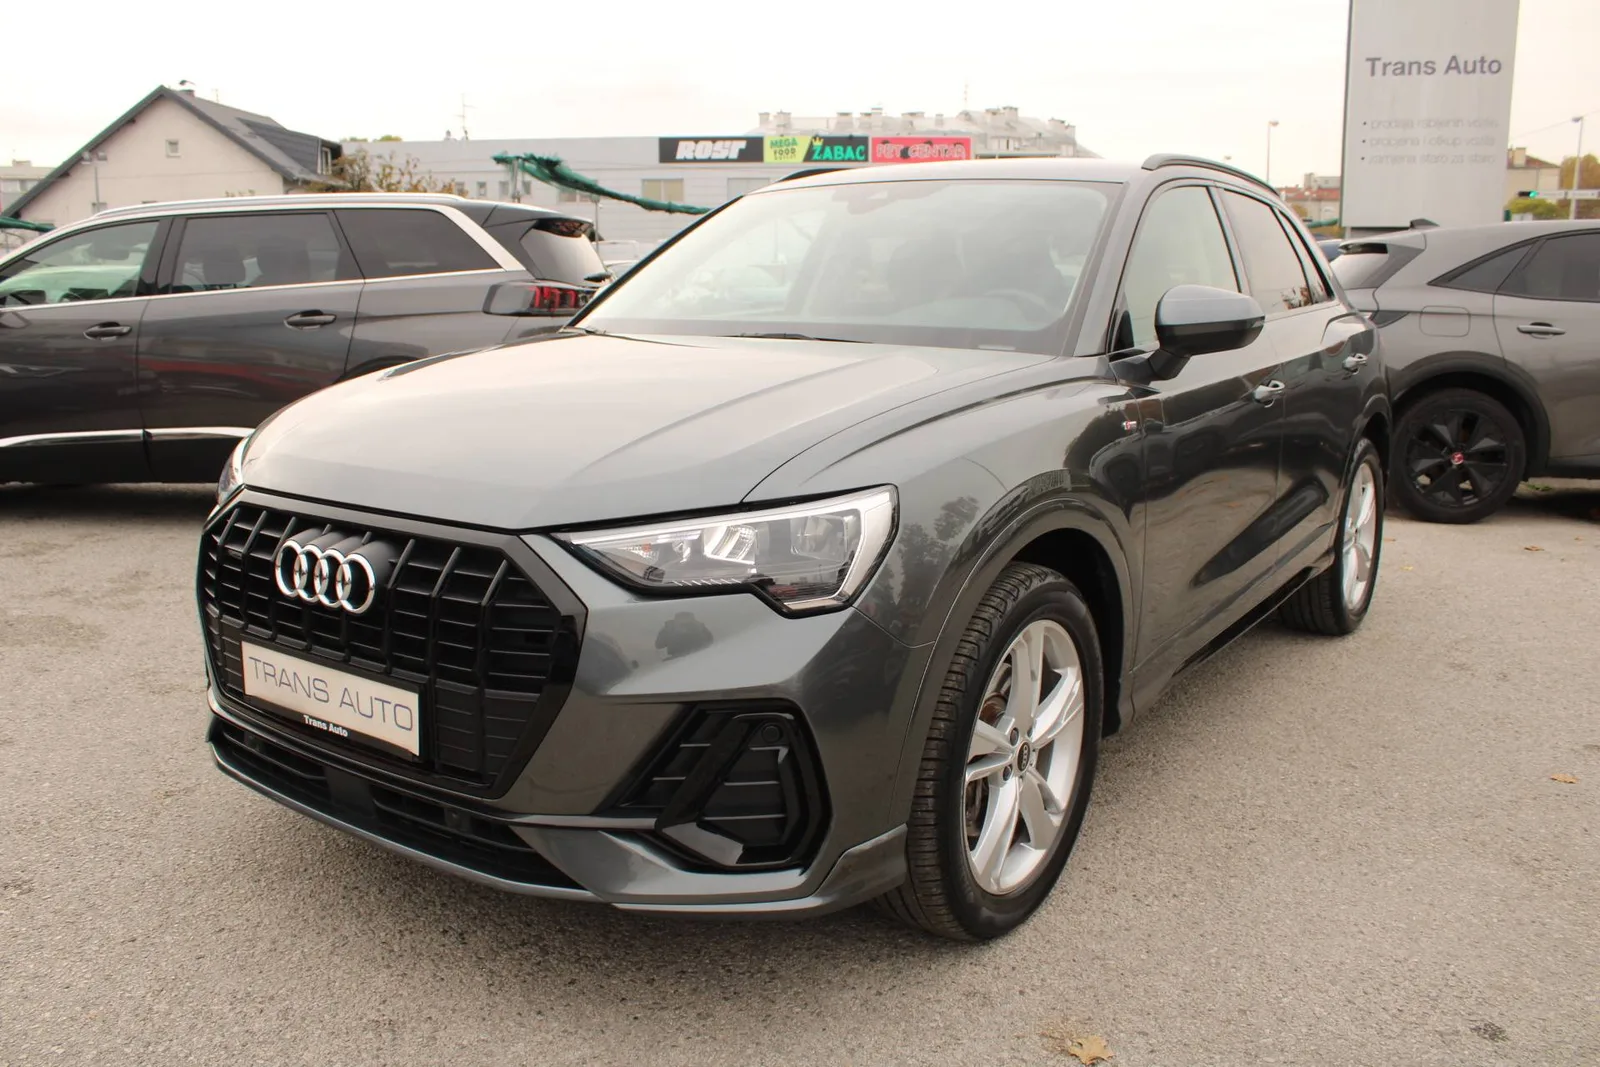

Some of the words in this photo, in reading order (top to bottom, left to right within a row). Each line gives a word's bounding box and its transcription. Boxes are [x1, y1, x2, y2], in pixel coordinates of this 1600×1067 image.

[1365, 57, 1437, 77] Trans
[1444, 55, 1502, 76] Auto
[675, 140, 747, 160] ROST
[769, 137, 798, 149] MEGA
[773, 148, 796, 156] FOOD
[876, 143, 903, 158] PET
[908, 143, 966, 161] CENTAR
[249, 656, 330, 704] TRANS
[339, 687, 413, 732] AUTO
[303, 714, 328, 731] Trans
[329, 723, 348, 737] Auto
